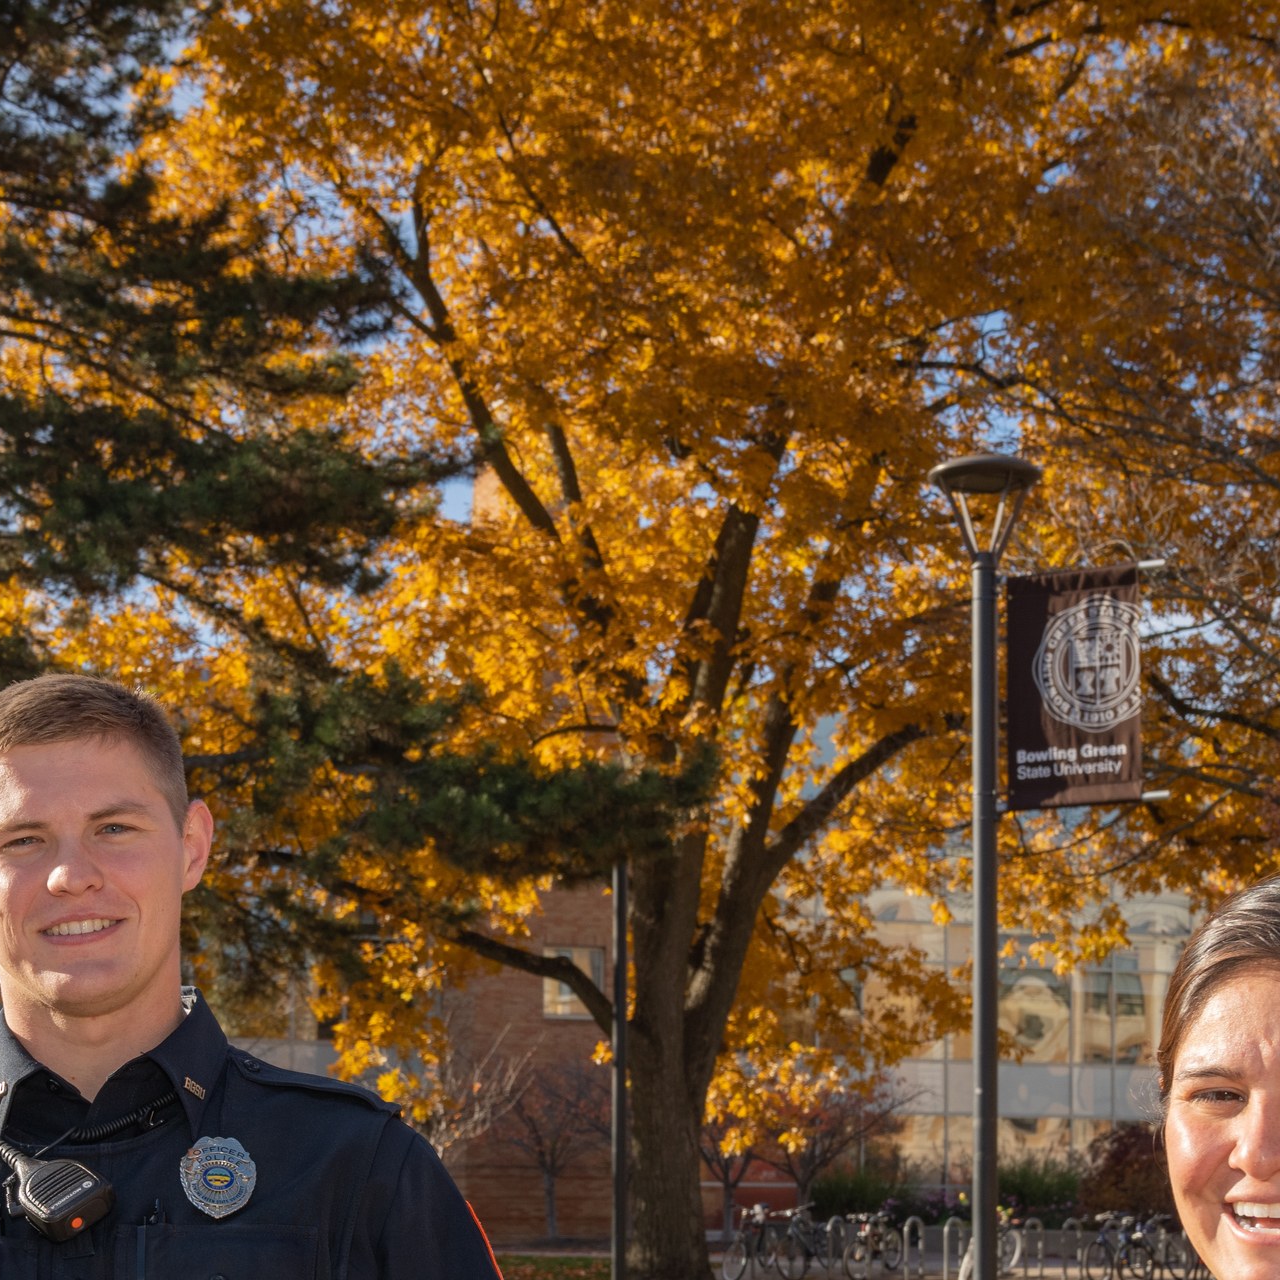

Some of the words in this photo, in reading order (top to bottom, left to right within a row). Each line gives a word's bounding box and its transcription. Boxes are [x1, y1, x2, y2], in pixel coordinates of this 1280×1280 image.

[1084, 710, 1115, 722] 1910
[1016, 746, 1077, 764] Bowling
[1080, 743, 1127, 758] Green
[1017, 764, 1051, 780] State
[1053, 758, 1122, 777] University
[184, 1076, 205, 1100] BGSU
[193, 1146, 245, 1159] OFFICER
[197, 1155, 242, 1166] POLICE
[51, 1187, 82, 1210] MOTOROLA
